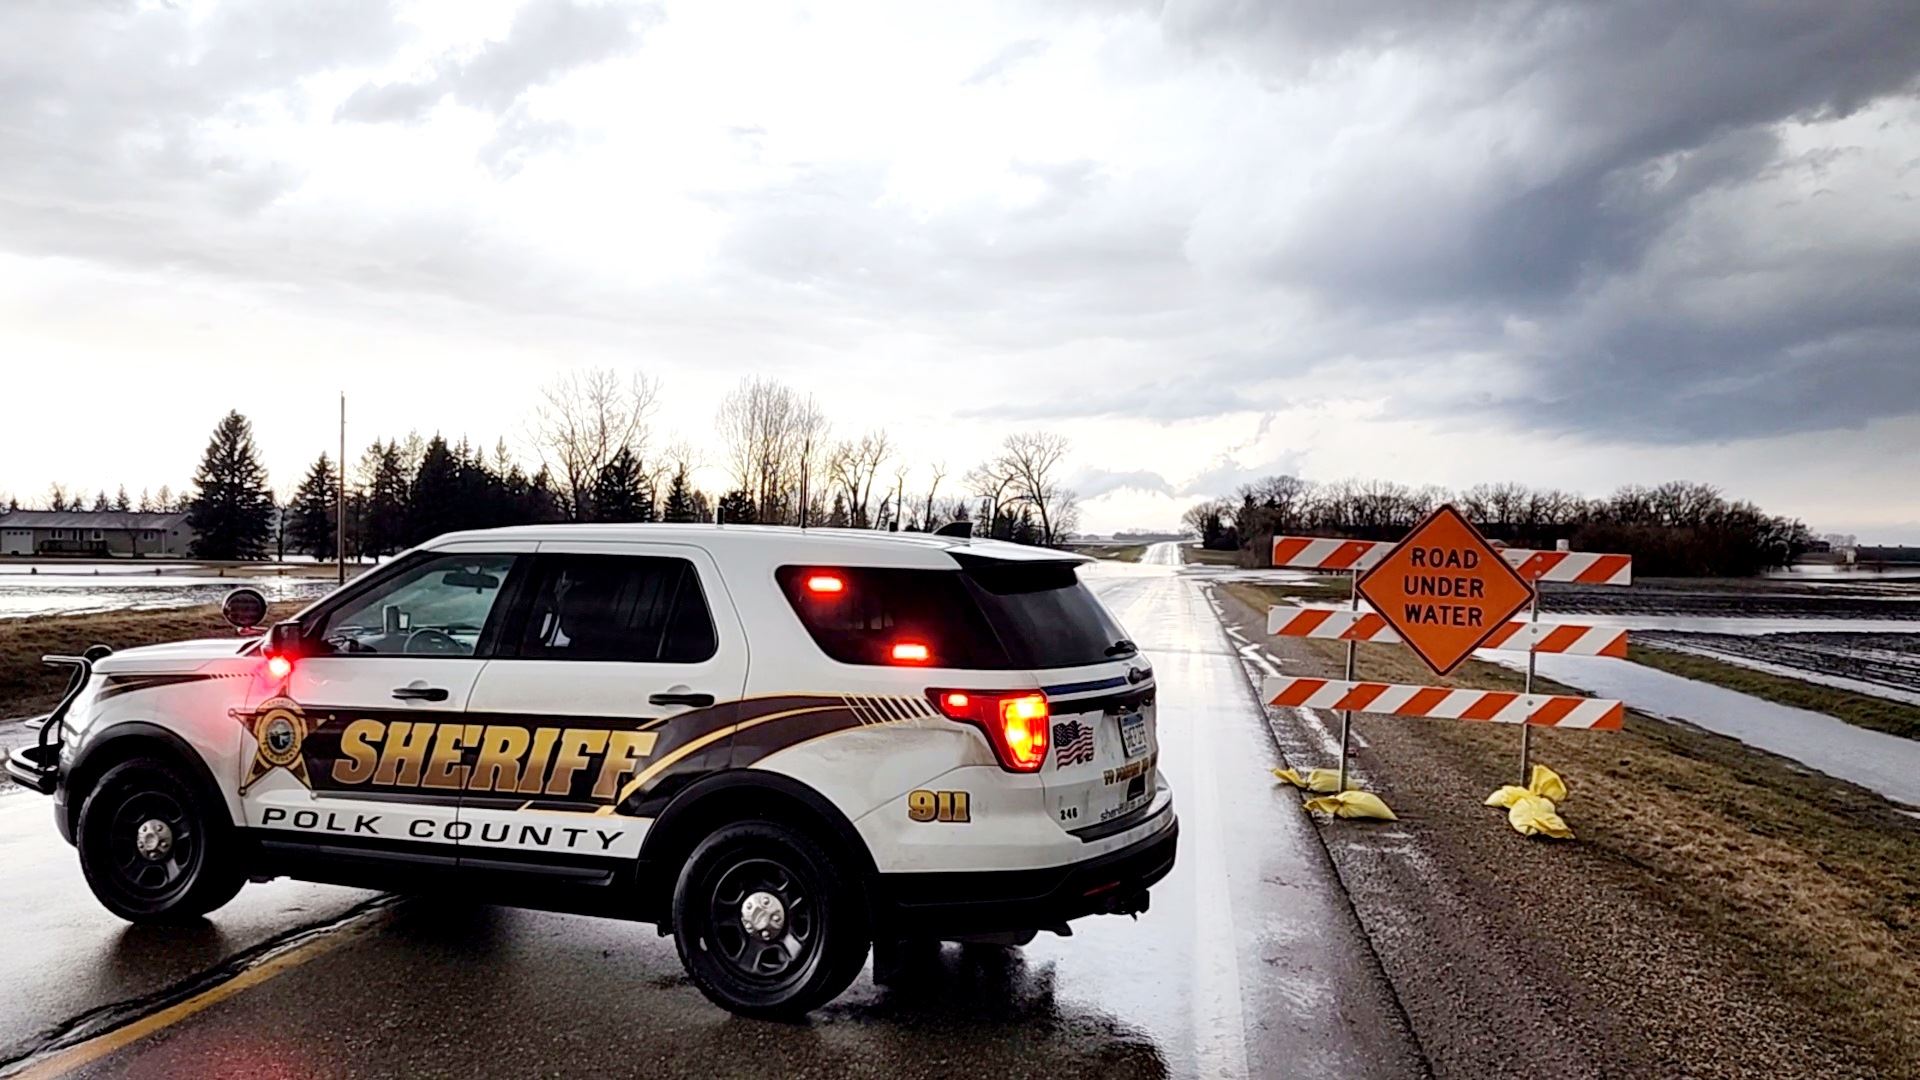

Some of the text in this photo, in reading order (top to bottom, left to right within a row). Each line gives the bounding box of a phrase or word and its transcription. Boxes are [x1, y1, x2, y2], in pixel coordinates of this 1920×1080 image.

[1411, 547, 1479, 569] ROAD
[1404, 575, 1484, 598] UNDER
[1404, 603, 1483, 627] WATER
[331, 719, 660, 799] SHERIFF
[908, 789, 971, 823] 911
[1060, 807, 1078, 821] 246
[261, 808, 625, 851] POLK COUNTY
